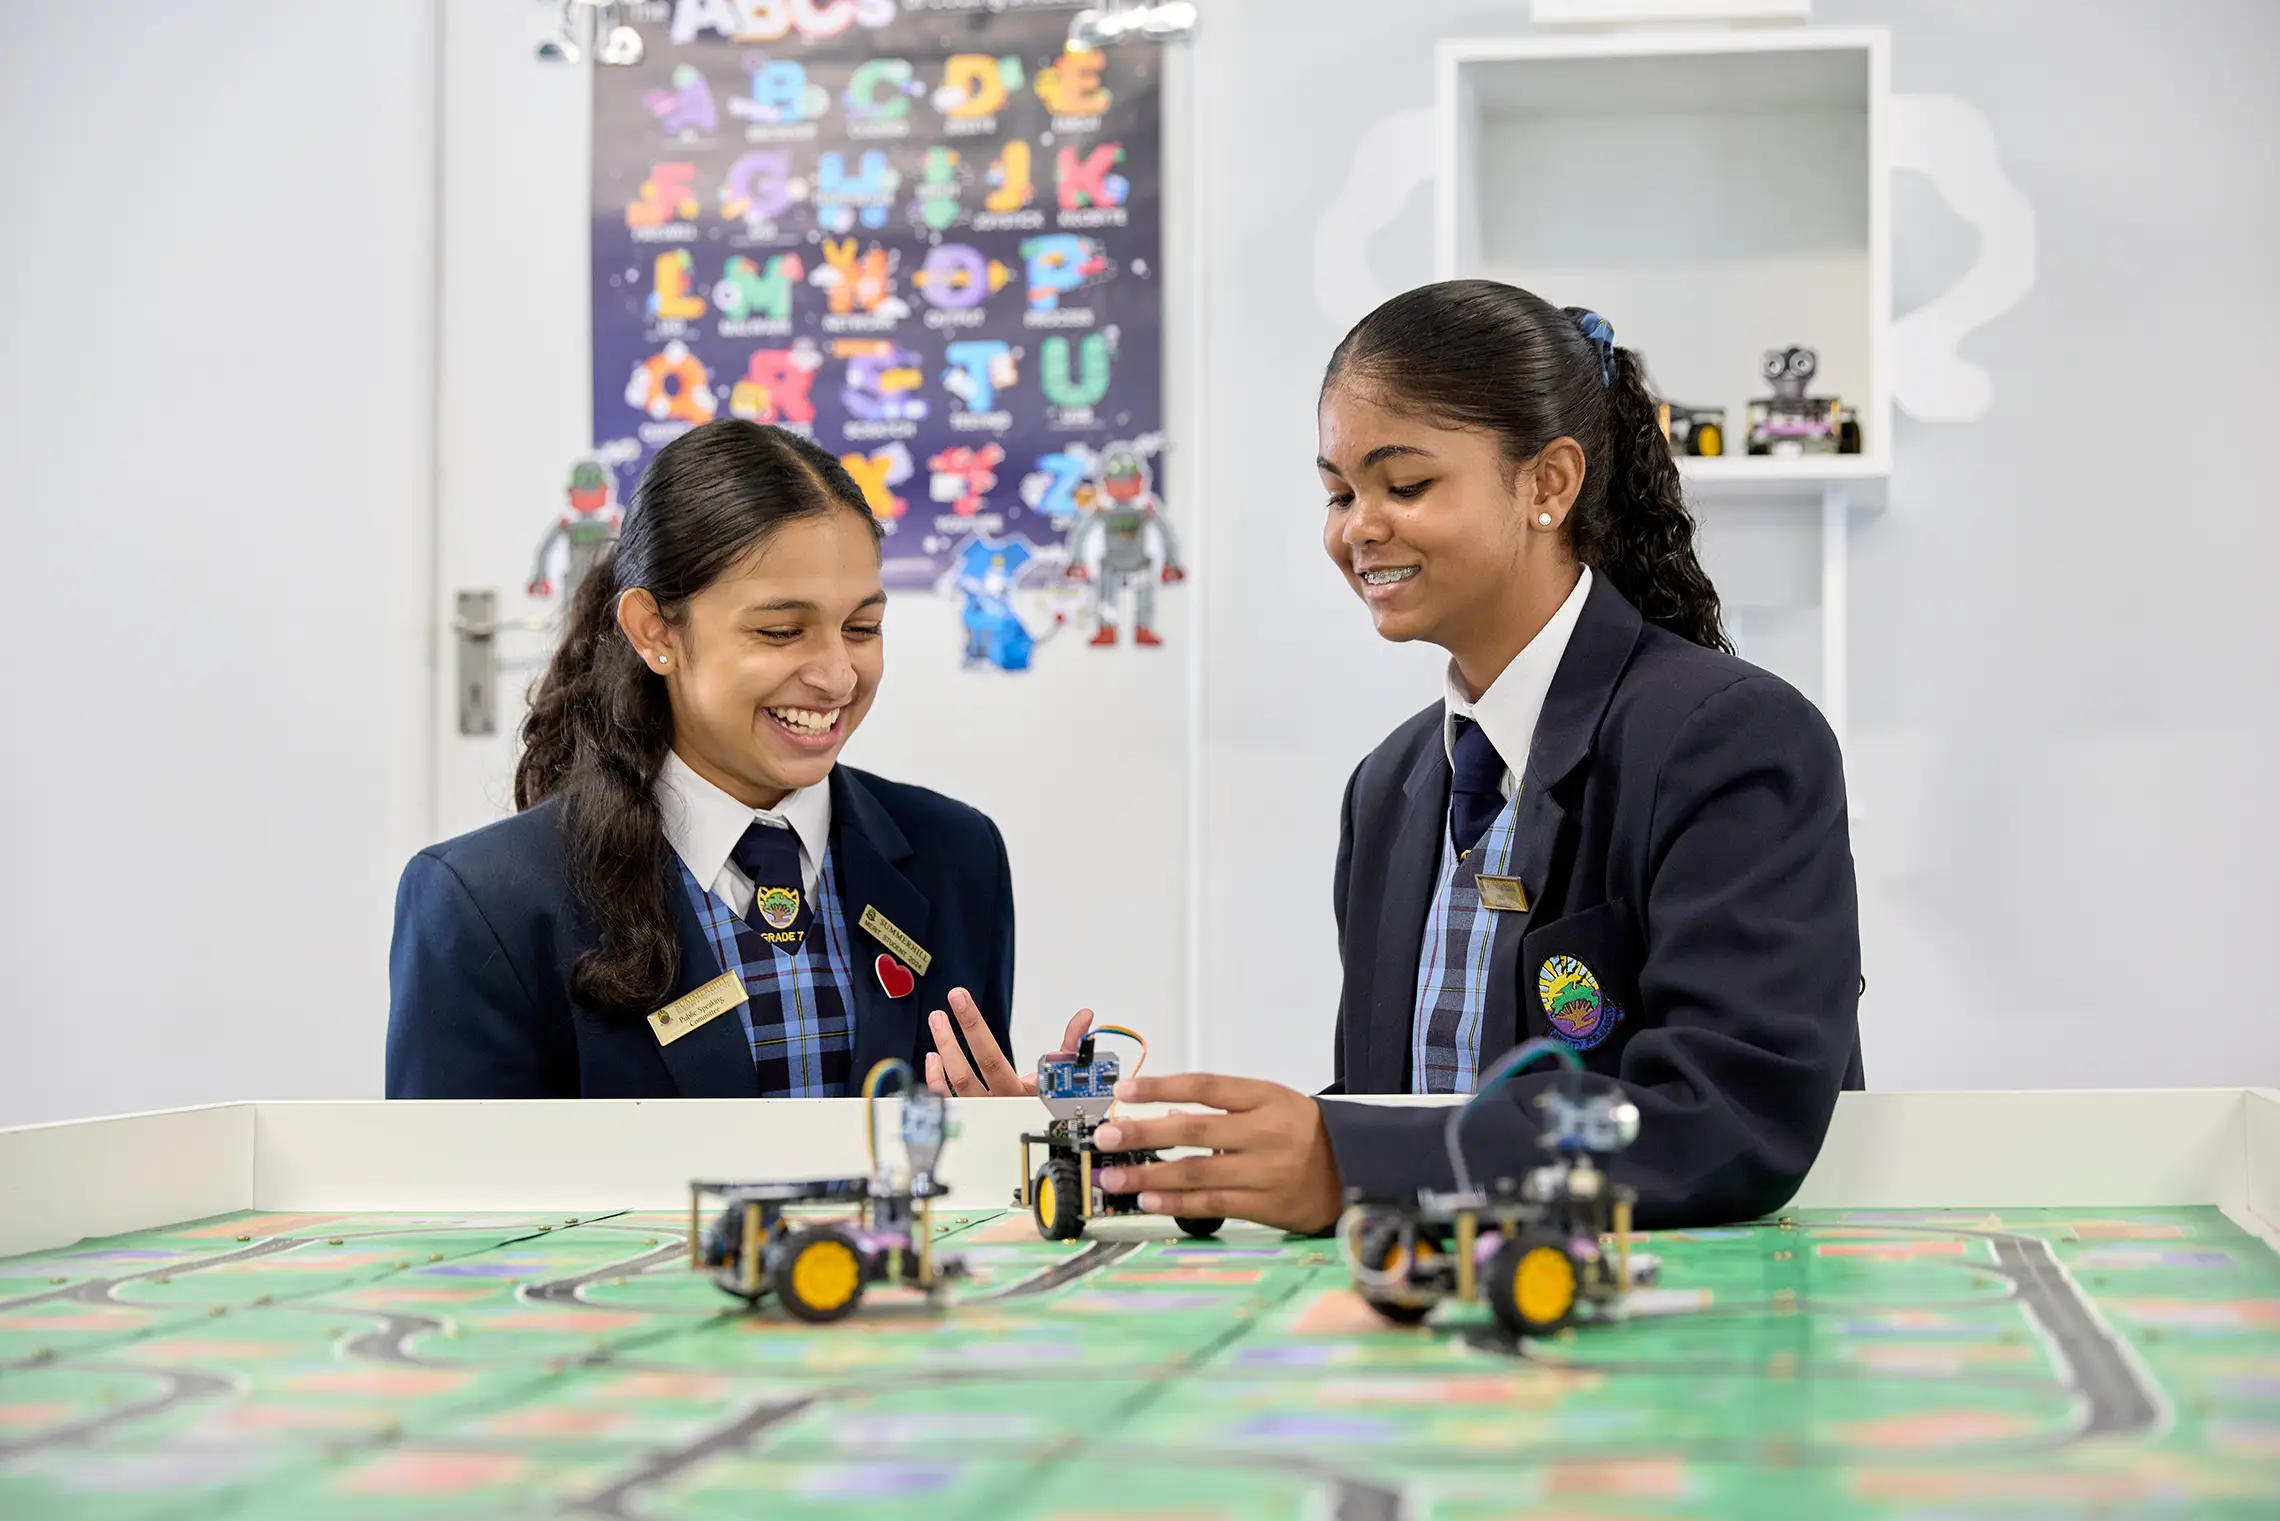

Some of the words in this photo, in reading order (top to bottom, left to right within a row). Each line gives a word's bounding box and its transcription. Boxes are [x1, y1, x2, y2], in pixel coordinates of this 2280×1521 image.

[752, 60, 806, 123] B
[848, 59, 912, 121] C
[944, 54, 1008, 118] D
[1053, 48, 1112, 116] E
[728, 152, 792, 220] G
[817, 150, 890, 230] H
[985, 140, 1034, 212] J
[1056, 143, 1126, 210] K
[655, 250, 706, 319] L
[722, 254, 796, 321] M
[920, 243, 990, 308] O
[1021, 234, 1100, 311] P
[748, 348, 816, 424] R
[945, 341, 1014, 412] T
[1040, 333, 1111, 407] U
[760, 931, 796, 943] GRADE
[797, 930, 805, 942] 7
[864, 919, 882, 935] MERIT
[882, 935, 907, 956] STUDENT
[880, 918, 929, 963] SUMMERHILL
[674, 976, 729, 1009] SUMMERHILL
[678, 1010, 697, 1024] Public
[698, 995, 725, 1014] Speaking
[690, 1007, 720, 1027] Committee
